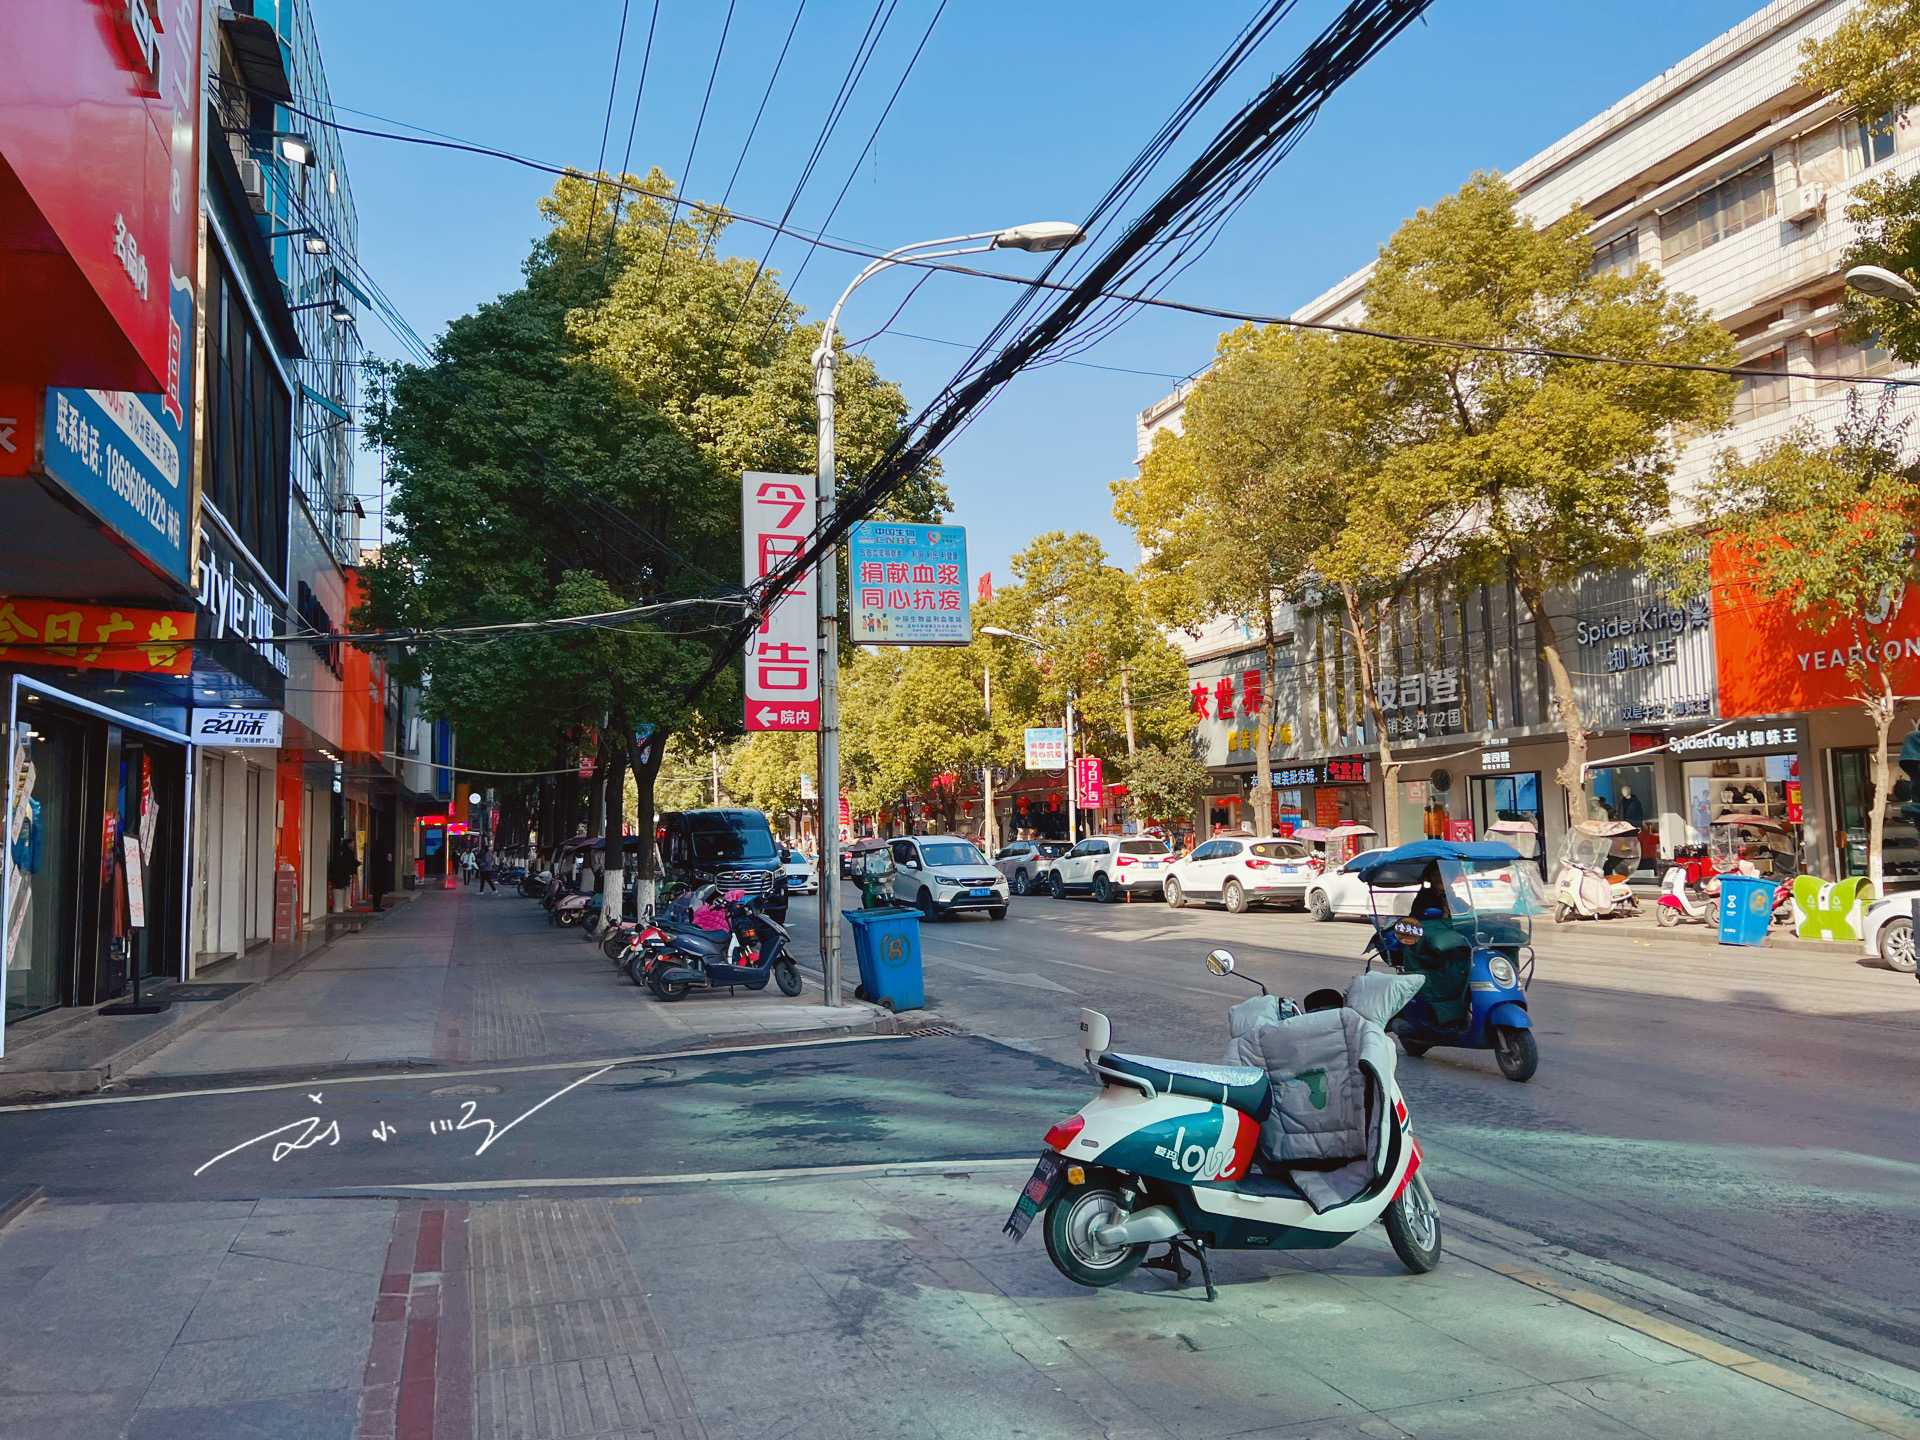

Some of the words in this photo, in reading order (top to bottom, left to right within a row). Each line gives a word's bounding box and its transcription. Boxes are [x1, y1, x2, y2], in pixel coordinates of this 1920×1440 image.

[105, 443, 167, 535] 18696081229
[875, 528, 915, 537] 中国生物
[875, 536, 916, 545] CNBG
[860, 561, 960, 585] 捐献血浆
[861, 588, 961, 612] 同心抗疫
[1577, 606, 1686, 647] SpiderKing
[1607, 639, 1677, 672] 蜘蛛王
[1189, 670, 1264, 723] 衣世界
[218, 712, 269, 720] STYLE
[780, 708, 810, 725] 院内
[1373, 708, 1461, 736] 销全球72国
[1669, 732, 1736, 754] SpiderKing
[1750, 727, 1798, 746] 蜘蛛王
[1088, 760, 1098, 801] 今日广告
[1172, 1126, 1236, 1178] love
